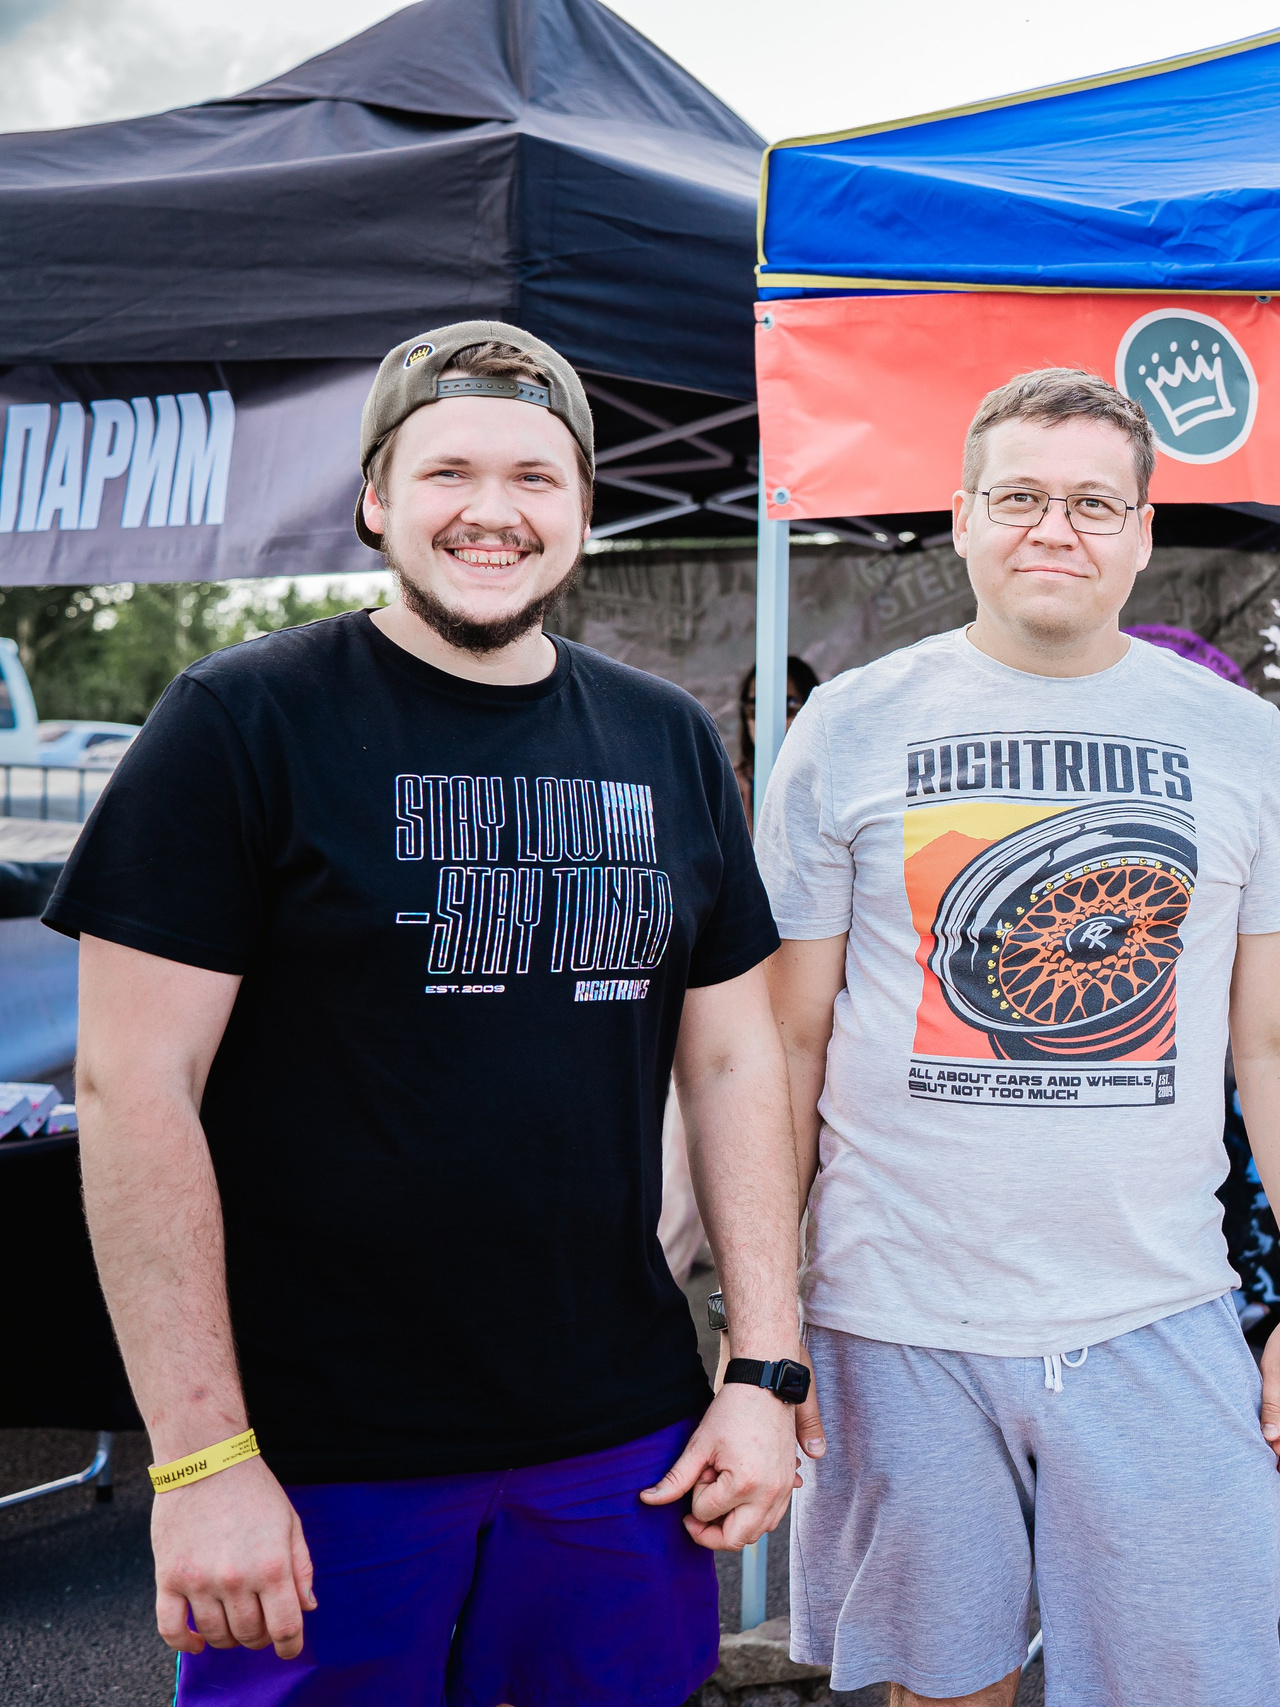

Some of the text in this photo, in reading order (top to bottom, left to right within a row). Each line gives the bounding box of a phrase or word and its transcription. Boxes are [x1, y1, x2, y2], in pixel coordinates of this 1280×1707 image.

[0, 390, 236, 534] ПАРИМ
[905, 739, 1193, 801] RIGHTRIDES
[395, 774, 603, 862] STAY LOW
[550, 867, 674, 973] TUNED
[573, 979, 651, 1002] RIGHTRIDES
[908, 1080, 1078, 1100] BUT NOT TOO MUCH
[909, 1067, 1154, 1088] ALL ABOUT CARS AND WHEELS,
